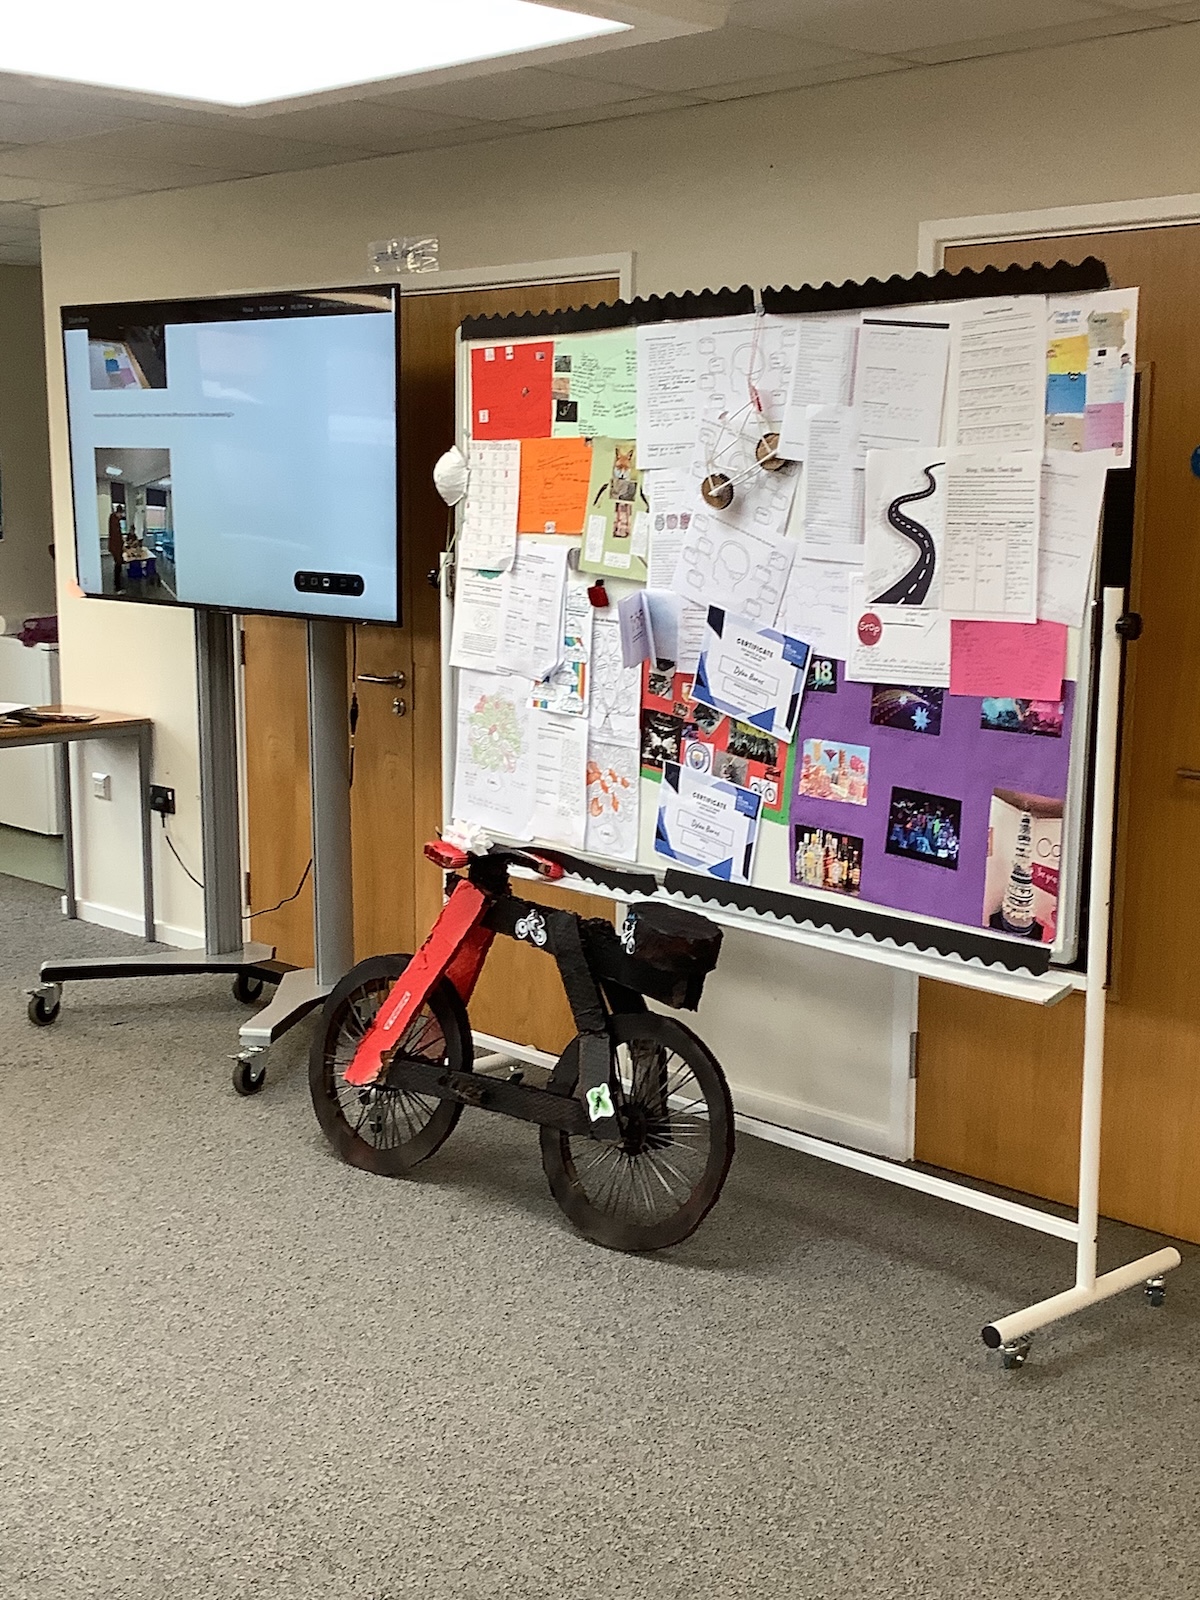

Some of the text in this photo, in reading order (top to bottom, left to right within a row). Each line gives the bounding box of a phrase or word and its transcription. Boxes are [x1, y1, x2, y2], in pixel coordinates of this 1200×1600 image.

[736, 638, 774, 658] CERTIFICATE
[811, 660, 833, 682] 18
[692, 792, 727, 810] CERTIFICATE
